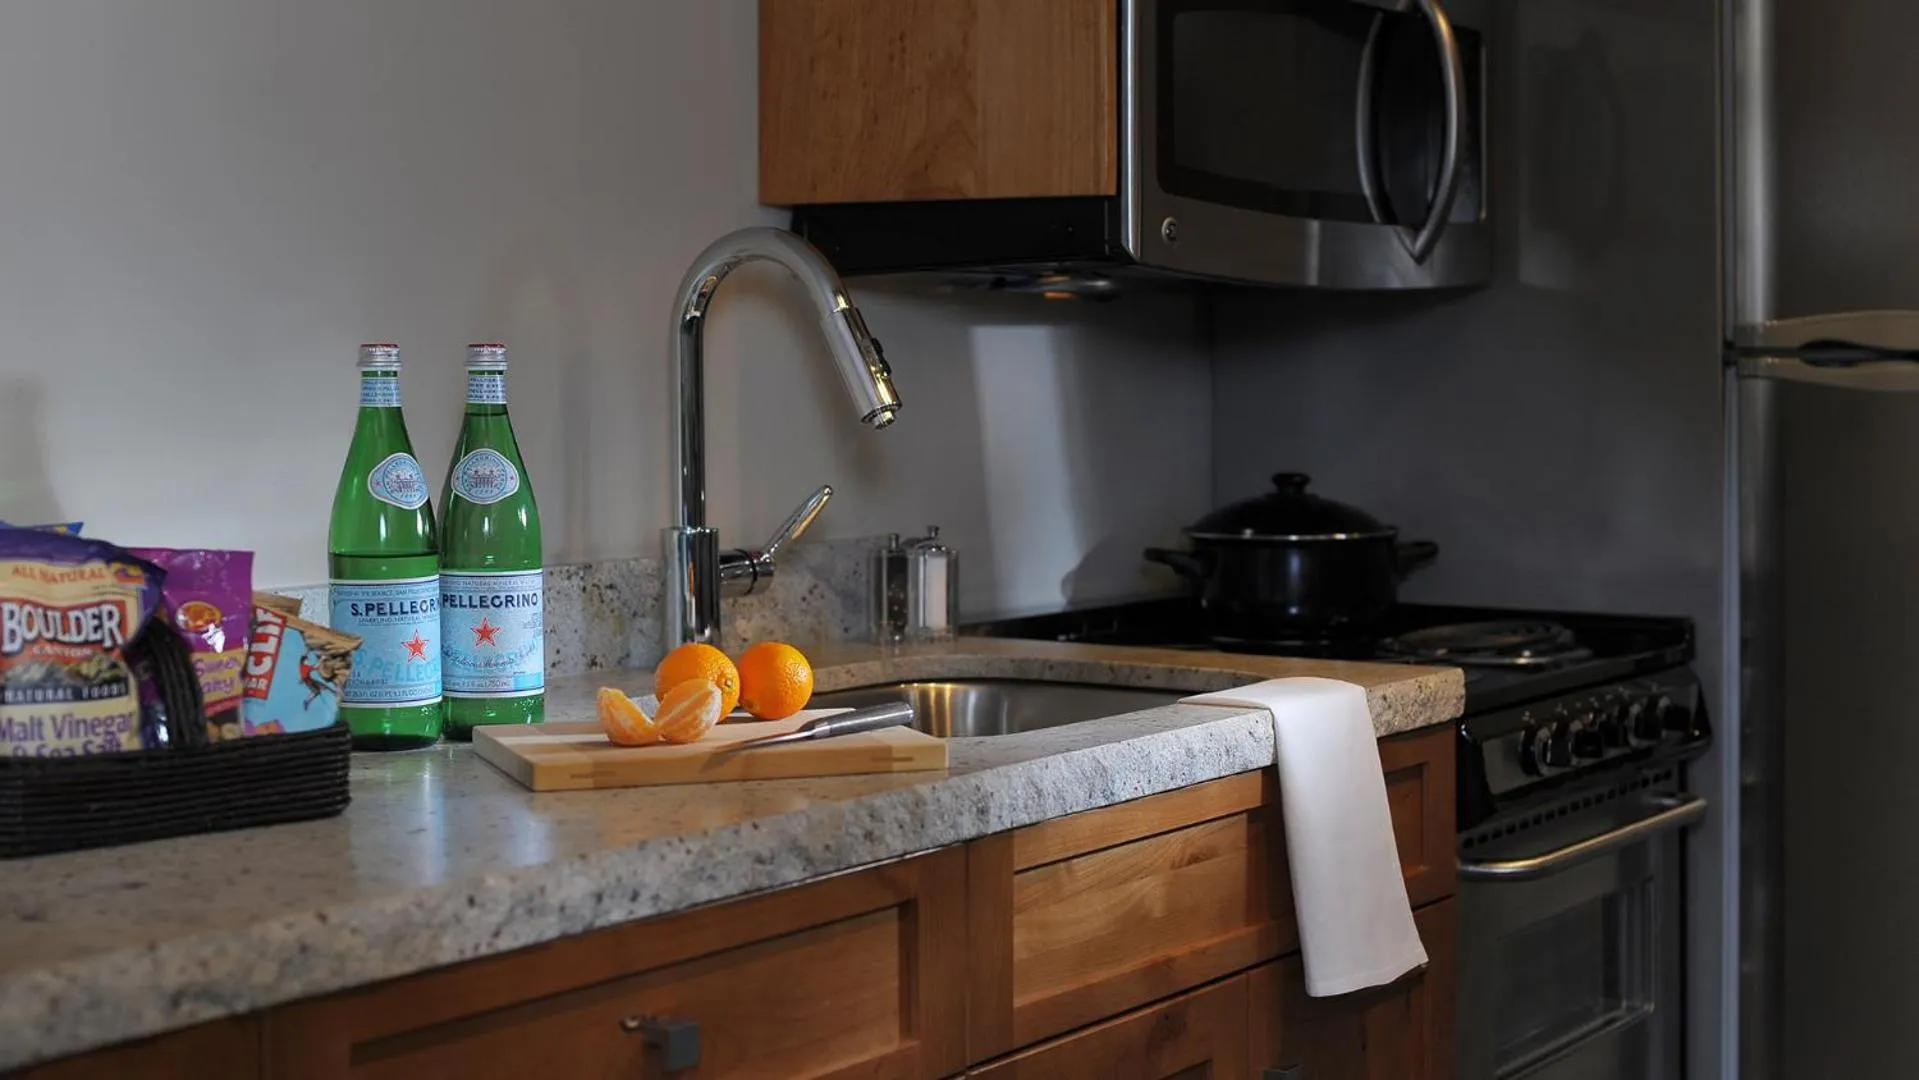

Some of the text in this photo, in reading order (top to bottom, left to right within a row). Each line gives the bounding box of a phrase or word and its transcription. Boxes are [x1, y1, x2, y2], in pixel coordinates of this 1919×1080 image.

[12, 564, 106, 585] ALL NATURAL
[442, 592, 538, 609] PELLEGRINO
[1, 602, 124, 652] BOULDER
[49, 711, 135, 744] Vinegar
